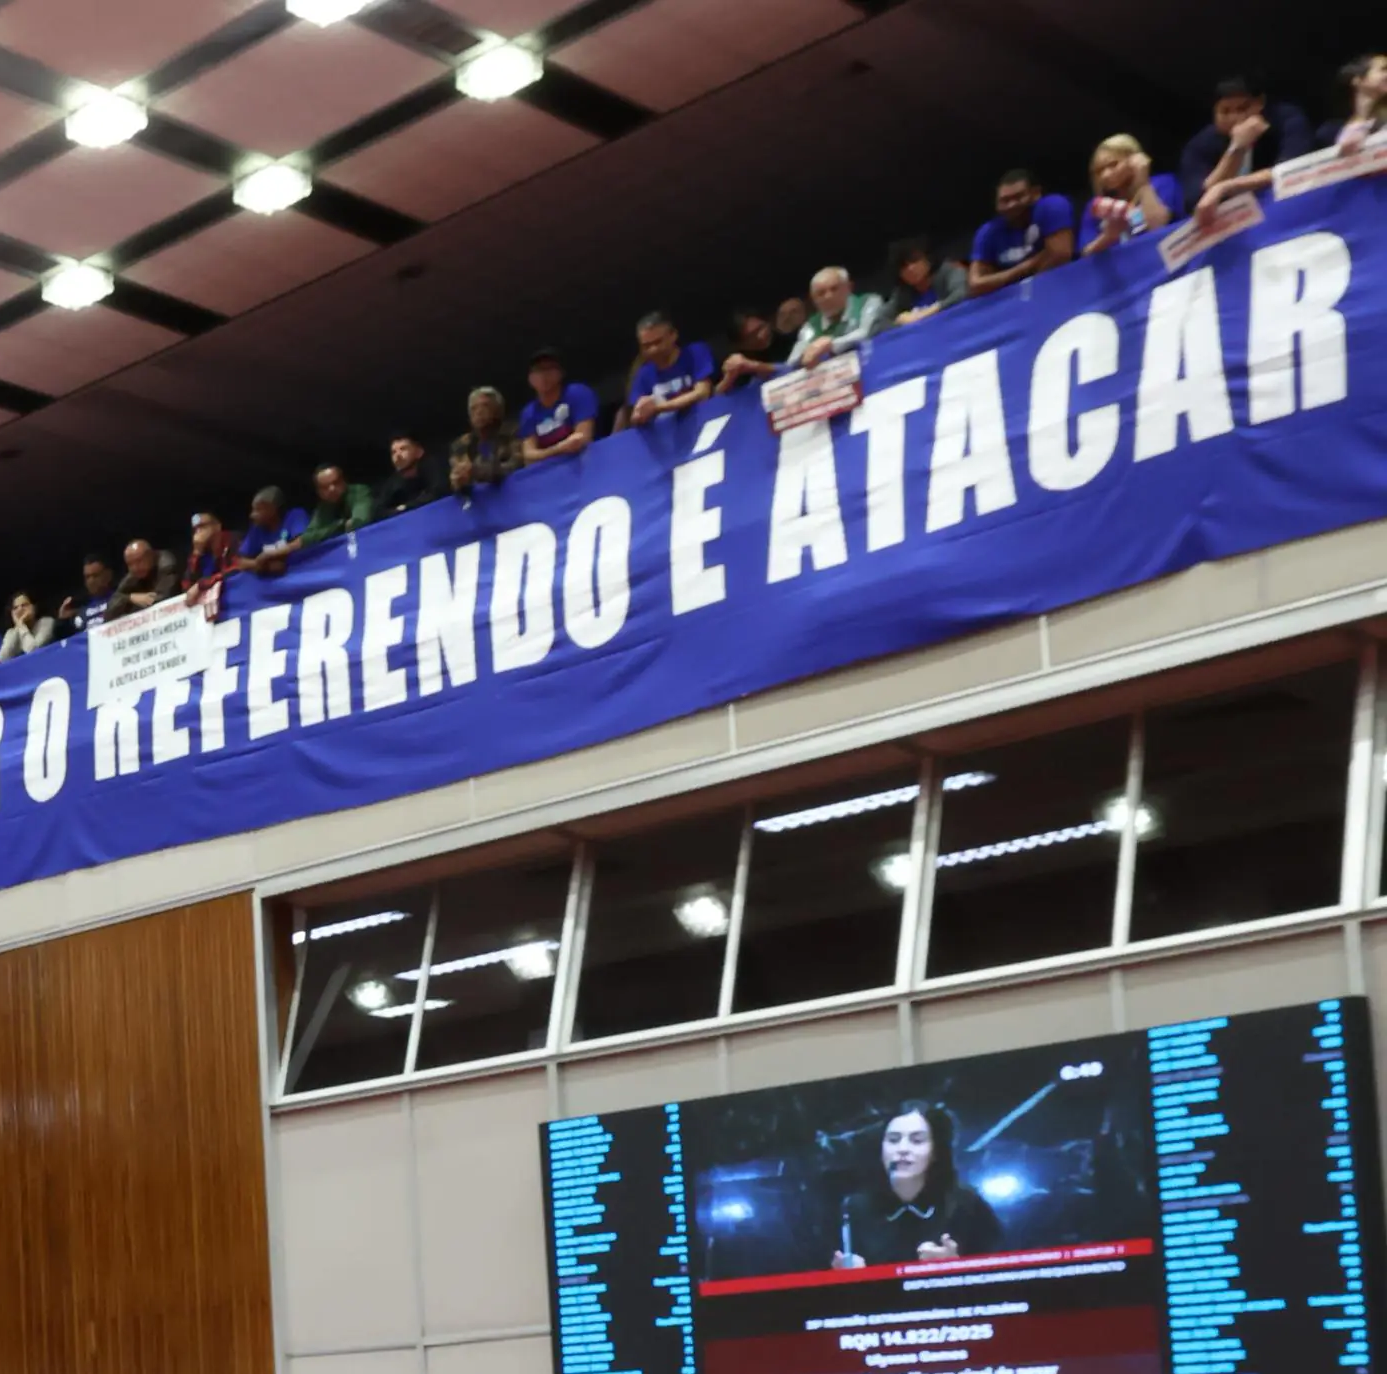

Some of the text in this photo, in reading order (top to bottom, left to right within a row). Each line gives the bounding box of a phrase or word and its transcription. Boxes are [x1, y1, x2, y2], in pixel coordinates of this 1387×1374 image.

[24, 676, 71, 803] O
[94, 496, 632, 781] REFERENDO
[670, 415, 731, 616] É
[767, 232, 1352, 584] ATACAR
